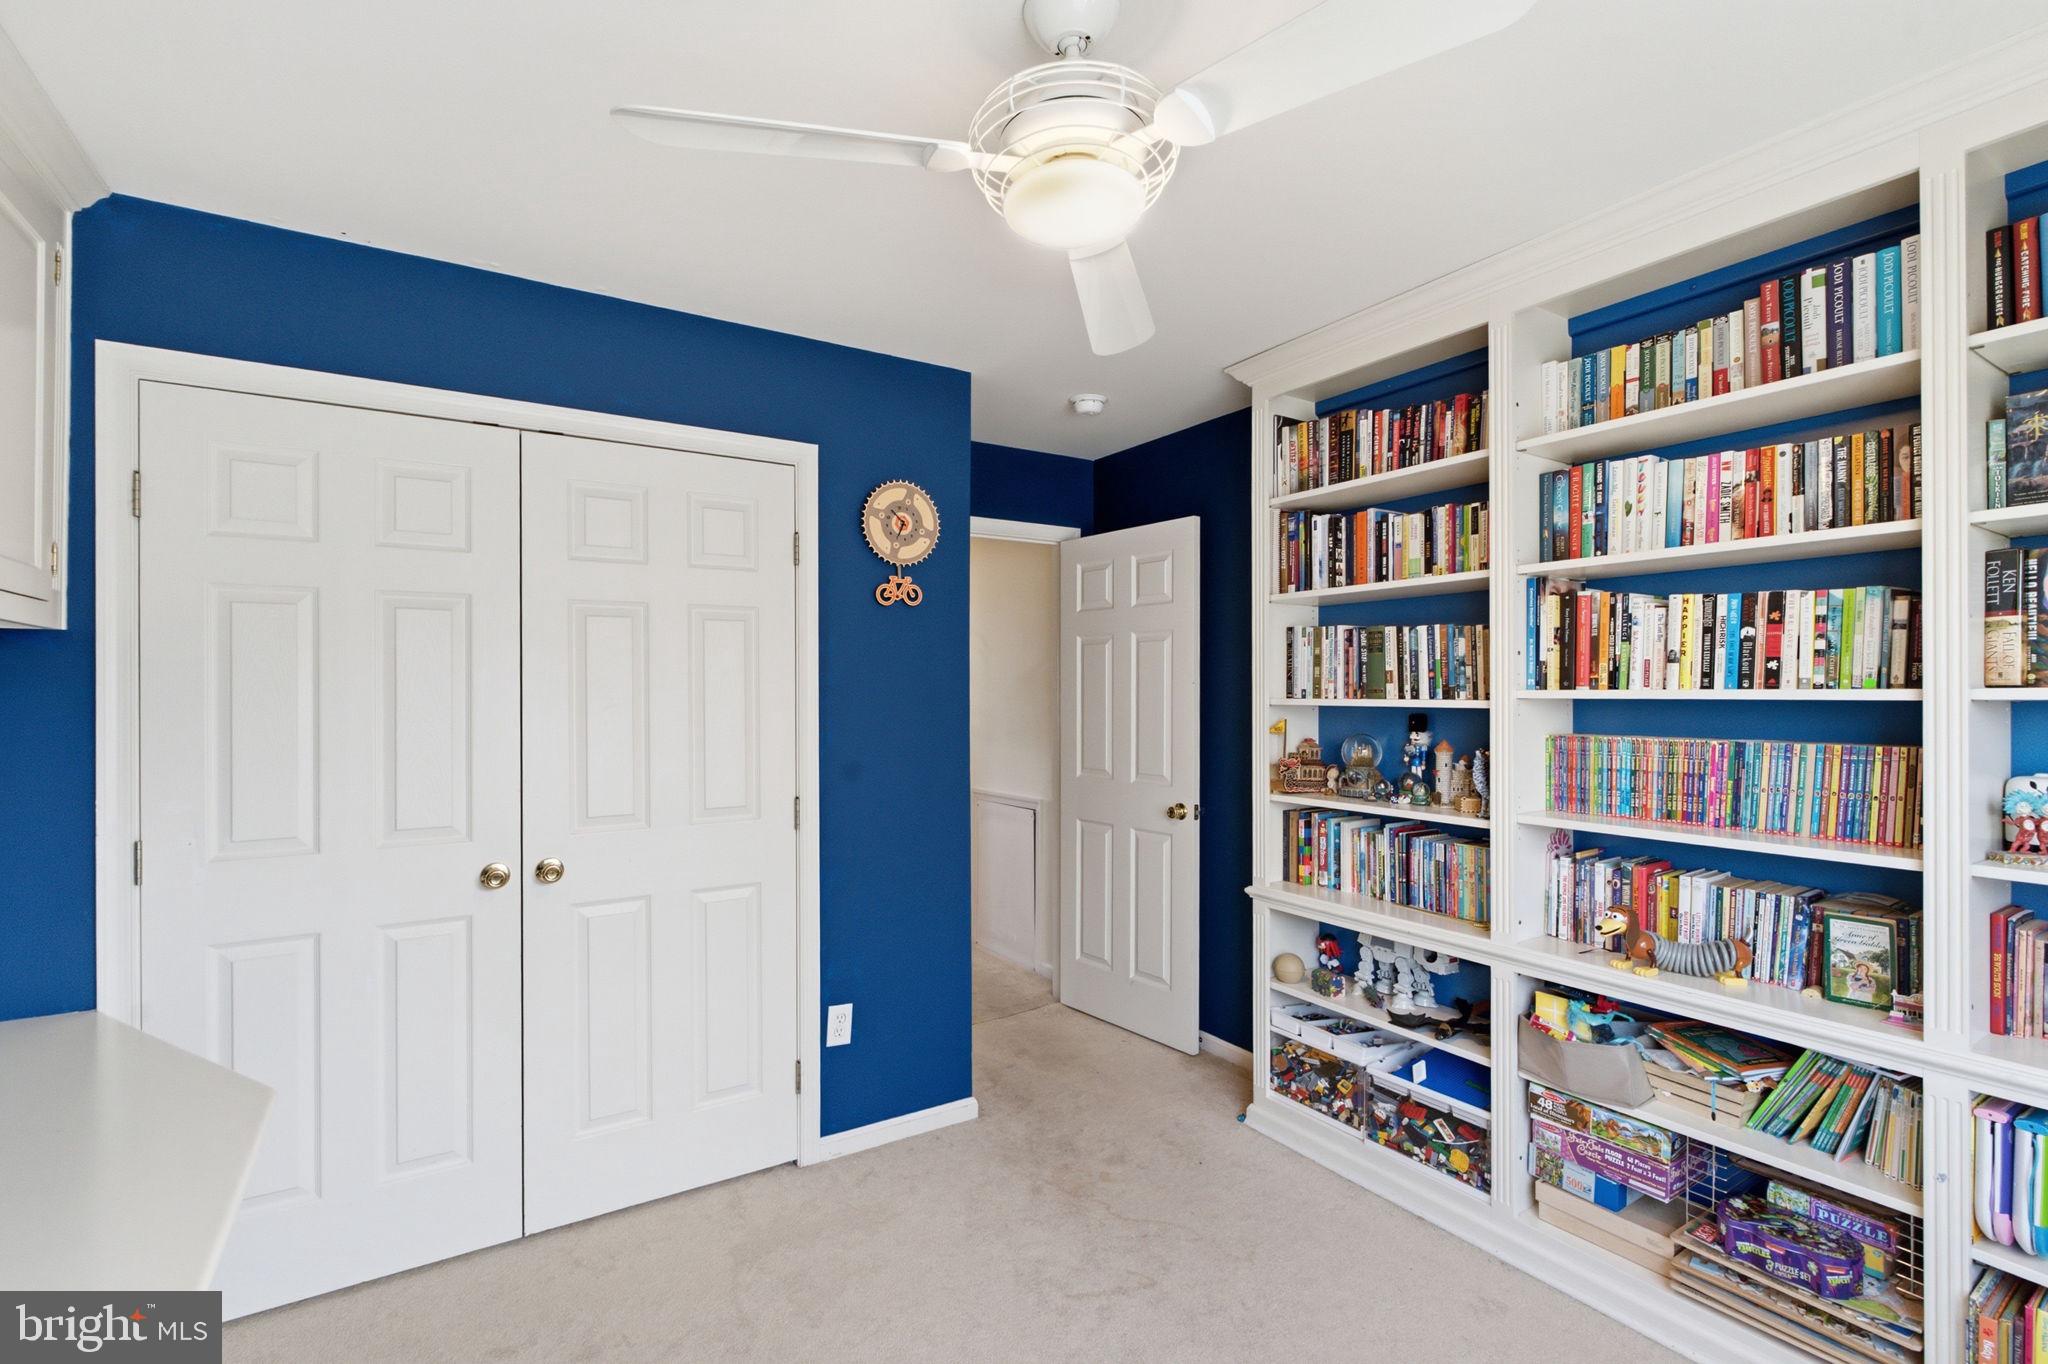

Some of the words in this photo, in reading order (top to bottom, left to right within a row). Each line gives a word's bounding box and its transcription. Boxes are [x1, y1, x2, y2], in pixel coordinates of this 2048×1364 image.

[1882, 252, 1894, 273] JODI
[1906, 240, 1919, 263] JODI
[1833, 263, 1844, 285] JODI
[1858, 266, 1868, 284] JODI
[2020, 250, 2030, 288] CATCHING
[1783, 279, 1795, 300] JODI
[1907, 266, 1919, 305] PICOULT
[1994, 267, 2002, 294] HUNGER
[1834, 287, 1843, 324] PICOULT
[1858, 286, 1869, 320] PICOULT
[1883, 275, 1894, 314] PICOULT
[2021, 290, 2030, 309] FIRE
[1784, 302, 1796, 342] PICOULT
[1584, 358, 1592, 373] JODI
[1838, 447, 1847, 459] THE
[1837, 461, 1847, 483] NANNY
[1720, 481, 1732, 500] ZADIE
[1720, 502, 1731, 524] SMITH
[1986, 560, 2000, 605] FOLLETT
[2002, 569, 2016, 593] KEN
[2027, 558, 2038, 588] HELLO
[2027, 591, 2038, 641] BEAUTIFUL
[1681, 598, 1690, 657] HAPPIER
[1986, 629, 1999, 673] GIANTS
[2002, 632, 2017, 652] FALL
[1742, 641, 1753, 674] Blackout
[2002, 654, 2017, 669] OF
[1537, 1097, 1553, 1110] 48
[1604, 1148, 1622, 1159] FLOOR
[1604, 1154, 1625, 1167] PUZZLE
[1634, 1158, 1651, 1170] Pieces
[1630, 1165, 1643, 1175] Feet
[1566, 1175, 1584, 1191] 500
[1817, 1207, 1889, 1243] PUZZLE
[1765, 1260, 1775, 1272] 3
[1774, 1262, 1799, 1276] PUZZLE
[1799, 1269, 1811, 1282] SET
